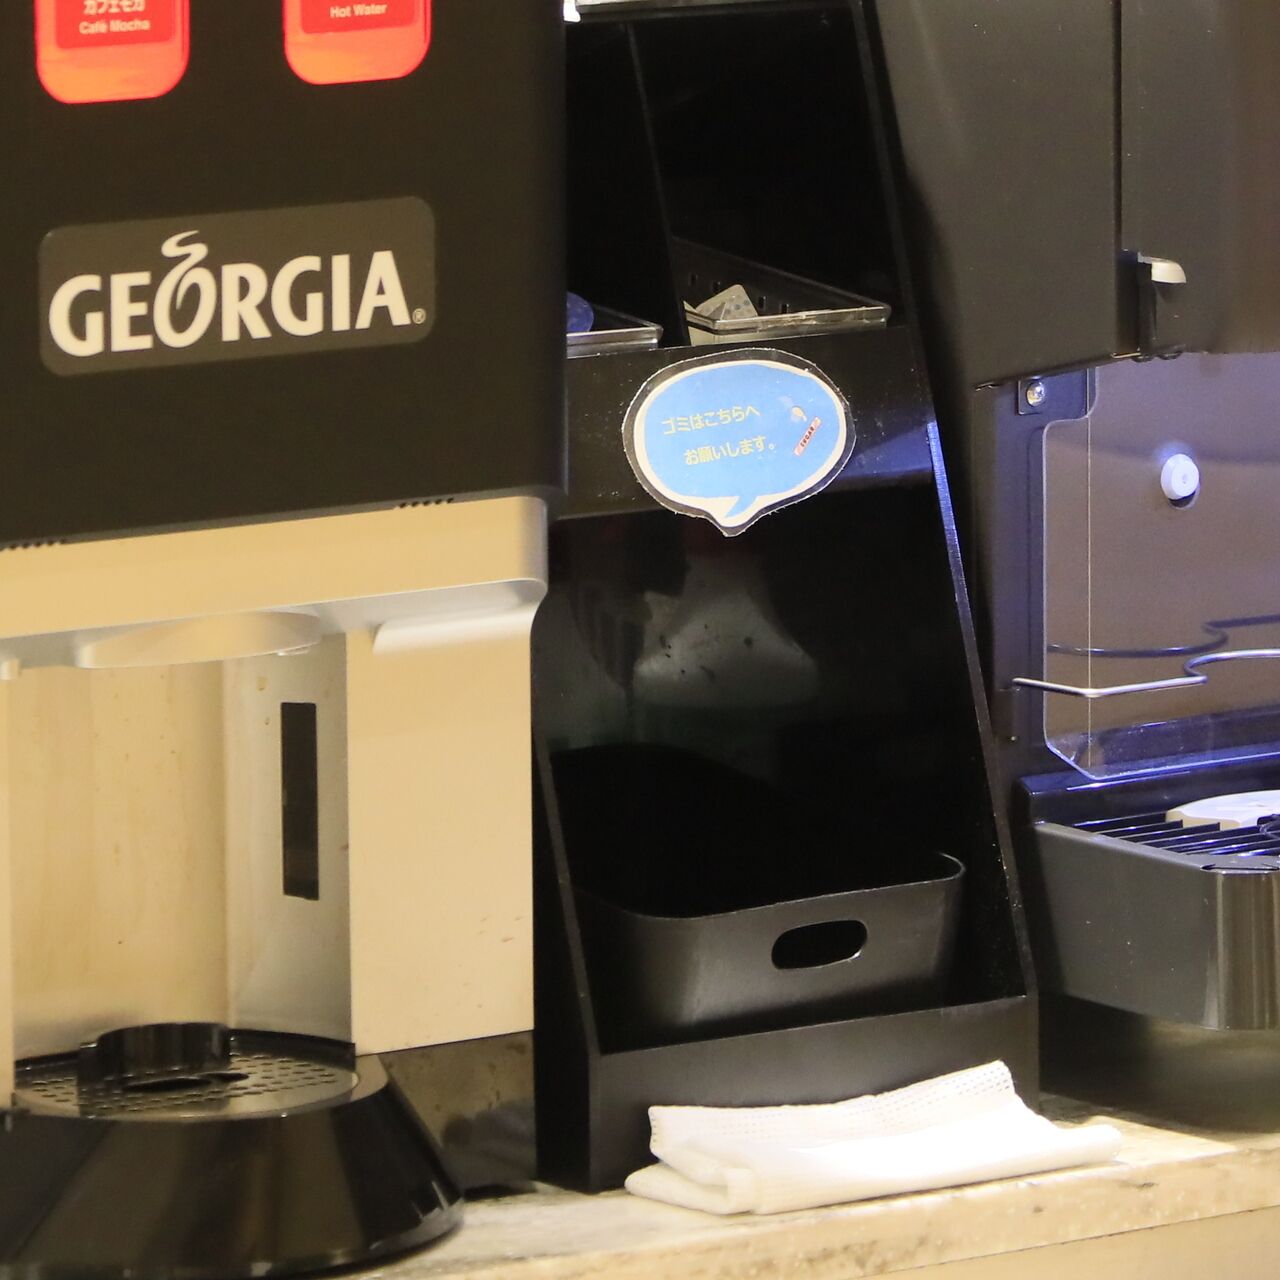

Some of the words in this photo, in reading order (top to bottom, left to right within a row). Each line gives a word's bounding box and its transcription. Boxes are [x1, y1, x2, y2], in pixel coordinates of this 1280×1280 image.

[330, 5, 351, 18] Hot
[352, 2, 388, 17] Water
[109, 18, 151, 33] Mocha
[48, 230, 413, 357] GEORGIA
[662, 405, 761, 436] ゴミはこちらへ
[684, 436, 776, 466] お願いします。
